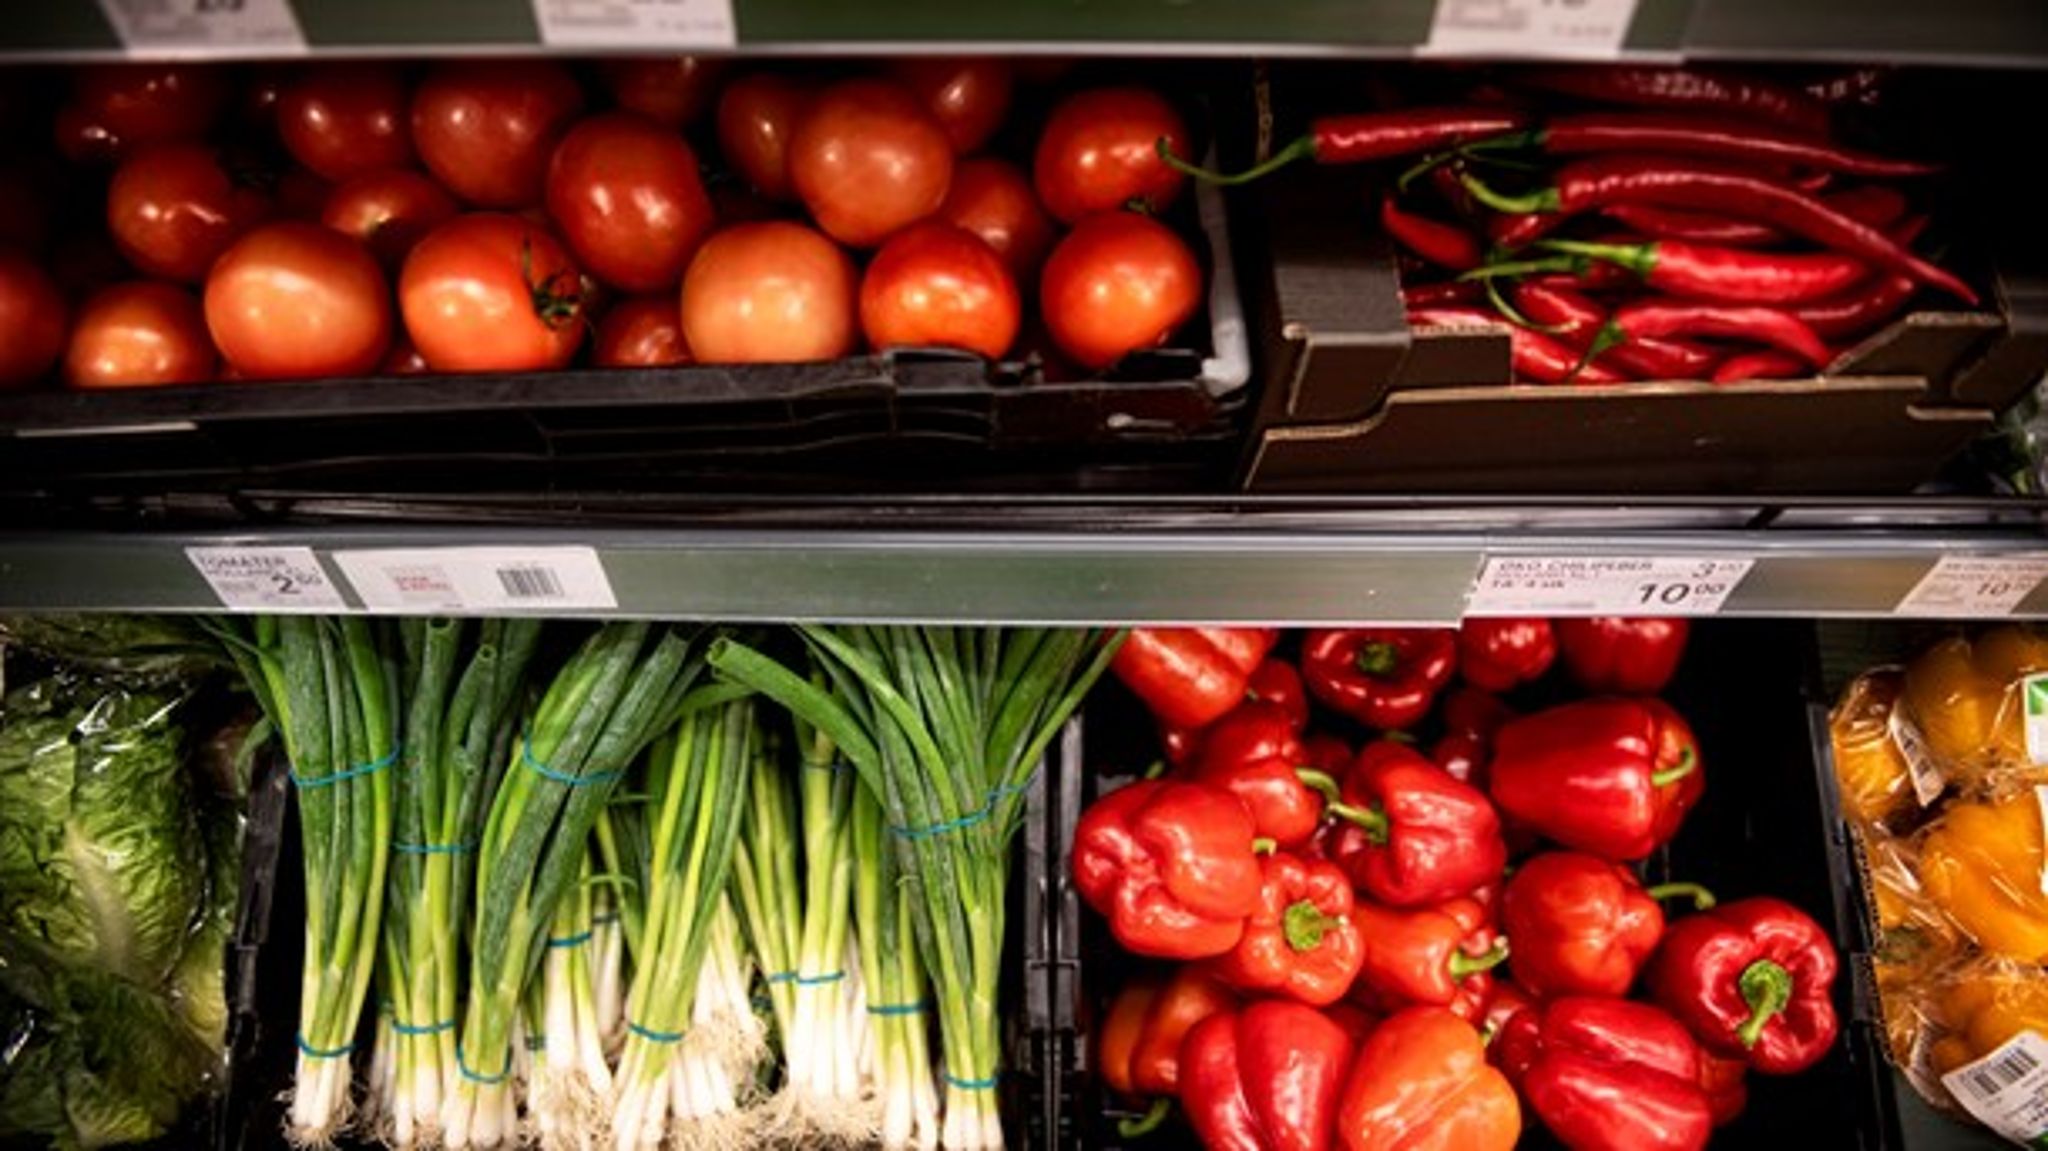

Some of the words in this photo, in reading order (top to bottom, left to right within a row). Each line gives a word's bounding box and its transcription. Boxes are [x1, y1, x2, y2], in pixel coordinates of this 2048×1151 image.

[1692, 562, 1716, 577] 3
[271, 572, 302, 594] 2
[1638, 583, 1690, 604] 10
